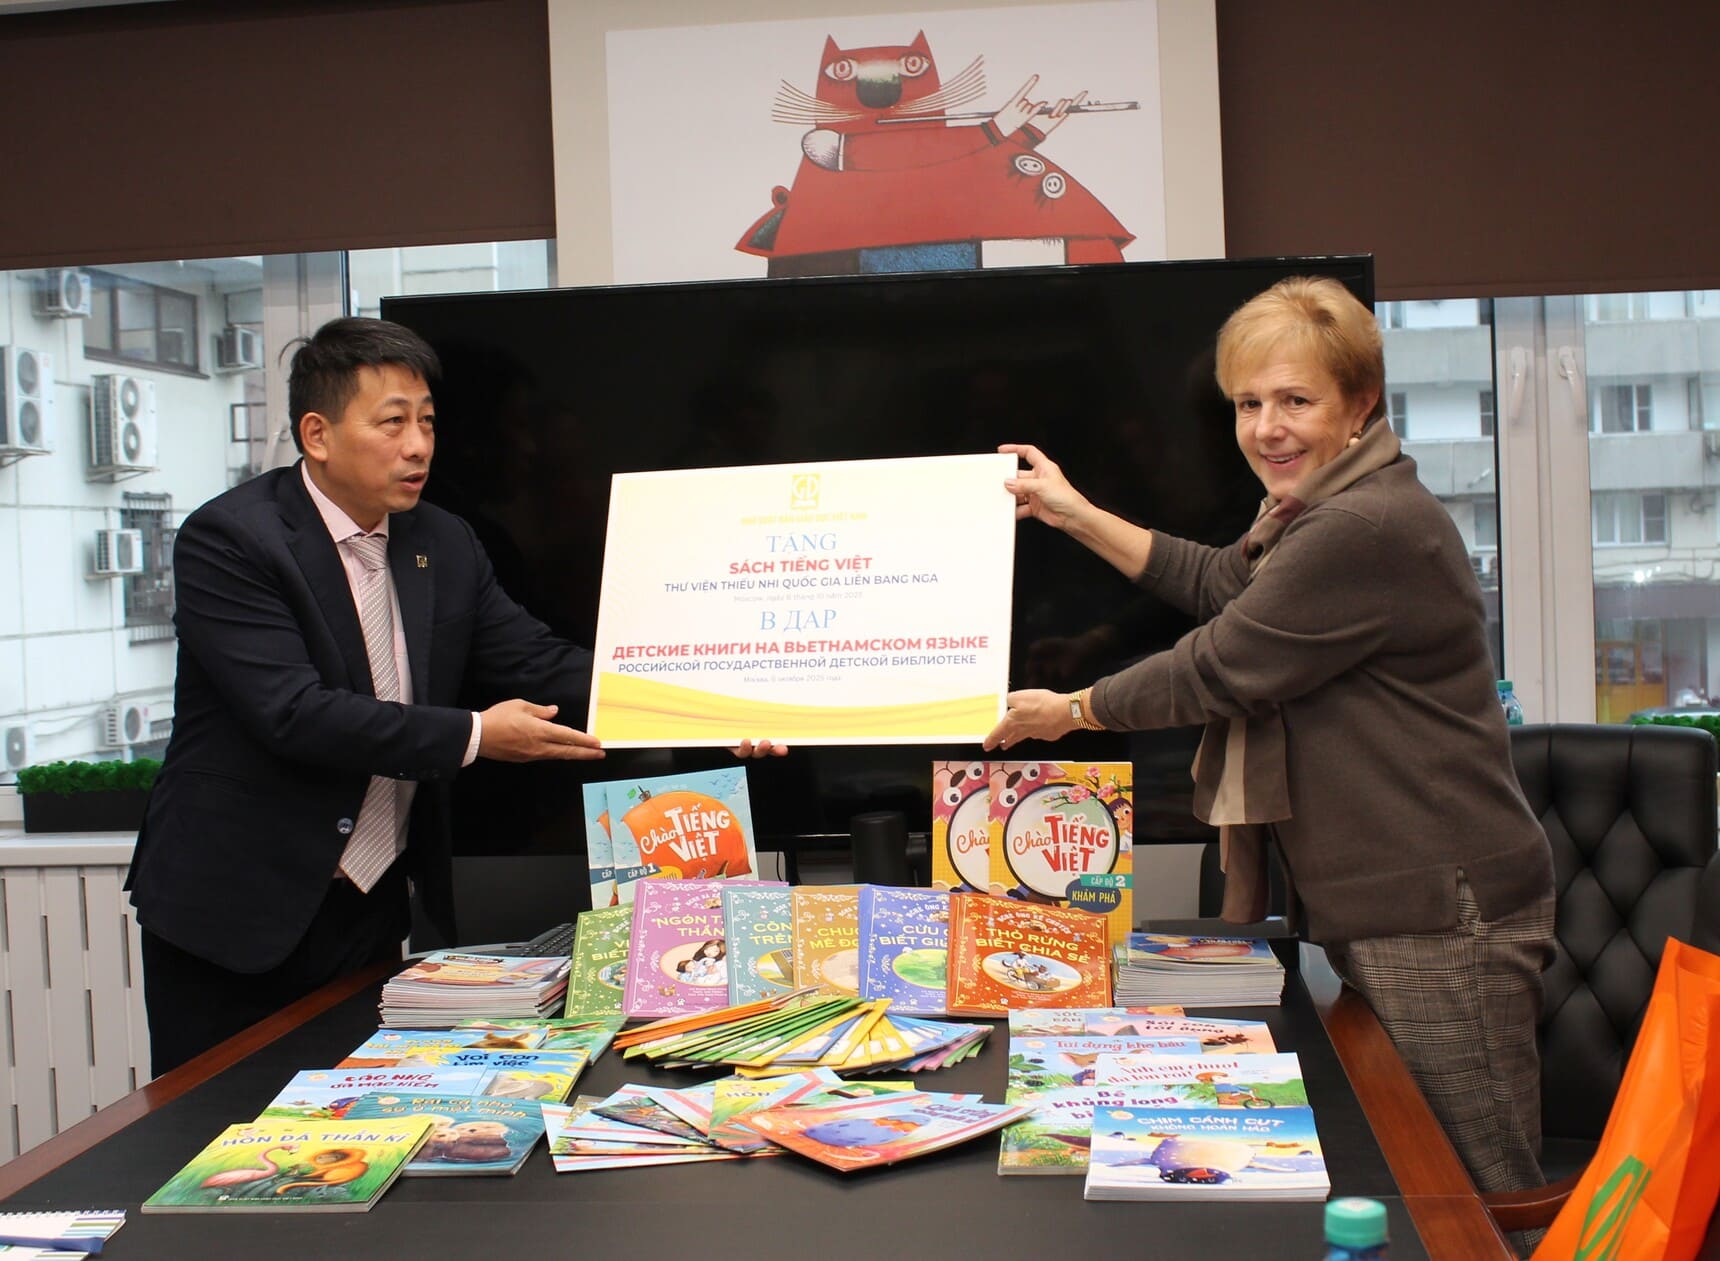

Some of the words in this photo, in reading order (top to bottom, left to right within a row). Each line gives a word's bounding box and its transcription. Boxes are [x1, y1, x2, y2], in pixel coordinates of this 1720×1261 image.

[729, 558, 775, 575] SÁCH
[780, 554, 829, 573] TIẾNG
[835, 554, 873, 573] VIỆT
[664, 582, 688, 592] THƯ
[721, 578, 755, 590] THIẾU
[758, 579, 779, 589] NHI
[782, 574, 817, 590] QUỐC
[820, 576, 841, 588] GIA
[844, 574, 871, 586] LIÊN
[874, 574, 909, 585] BANG
[912, 573, 938, 584] NGA
[760, 611, 776, 631] В
[784, 609, 837, 632] ДАР
[612, 644, 690, 660] ДЕТСКИЕ
[693, 643, 751, 656] КНИГИ
[755, 641, 779, 654] НА
[784, 638, 921, 653] ВЬЕТНАМСКОМ
[926, 636, 989, 650] ЯЗЫКЕ
[618, 660, 700, 673] РОССИЙСКОЙ
[704, 656, 826, 671] ГОСУДАРСТВЕННОЙ
[829, 655, 888, 669] ДЕТСКОЙ
[891, 654, 977, 667] БИБЛИОТЕКЕ
[664, 803, 731, 836] TIẾNG
[640, 824, 678, 855] Chào
[1044, 814, 1110, 849] TIẾNG
[669, 831, 720, 862] VIỆT
[1013, 831, 1051, 855] Chào
[648, 862, 657, 873] 1
[1042, 846, 1095, 877] VIỆT
[1115, 875, 1126, 887] 2
[1071, 889, 1095, 902] KHÁM
[1099, 888, 1116, 904] PHÁ
[711, 915, 723, 925] T
[879, 932, 918, 945] BIẾT
[975, 937, 1016, 950] BIẾT
[1019, 943, 1062, 959] CHIA
[986, 927, 1024, 940] THỎ
[1028, 934, 1079, 952] RỪNG
[456, 1052, 488, 1061] Voi
[1052, 1097, 1125, 1107] khủng
[1136, 1116, 1182, 1125] CHIM
[1189, 1114, 1238, 1125] CÁNH
[222, 1133, 273, 1147] HÒN
